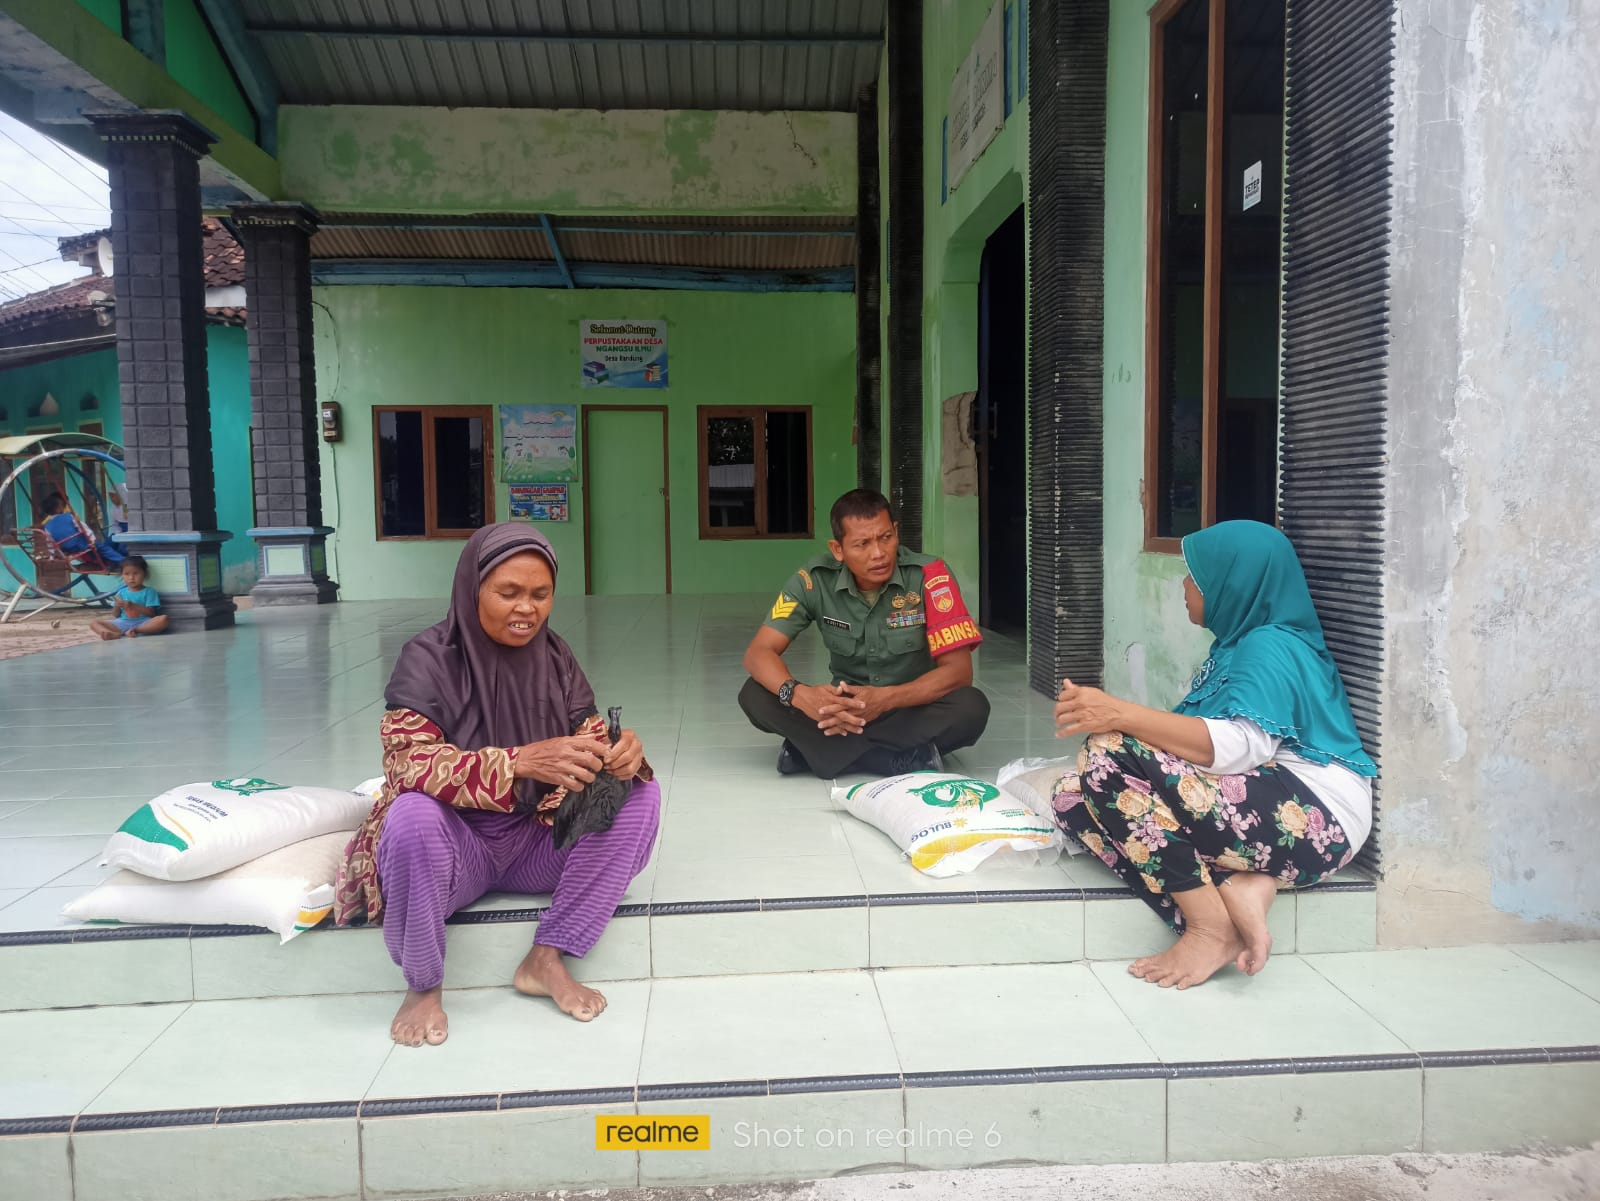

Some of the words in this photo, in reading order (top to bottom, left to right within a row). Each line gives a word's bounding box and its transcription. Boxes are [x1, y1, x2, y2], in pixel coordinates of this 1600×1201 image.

[590, 323, 625, 334] Selamat
[584, 337, 643, 345] PERPUSTAKAAN
[644, 337, 663, 345] DESA
[928, 620, 980, 652] BABINSA
[911, 821, 952, 843] BULOG
